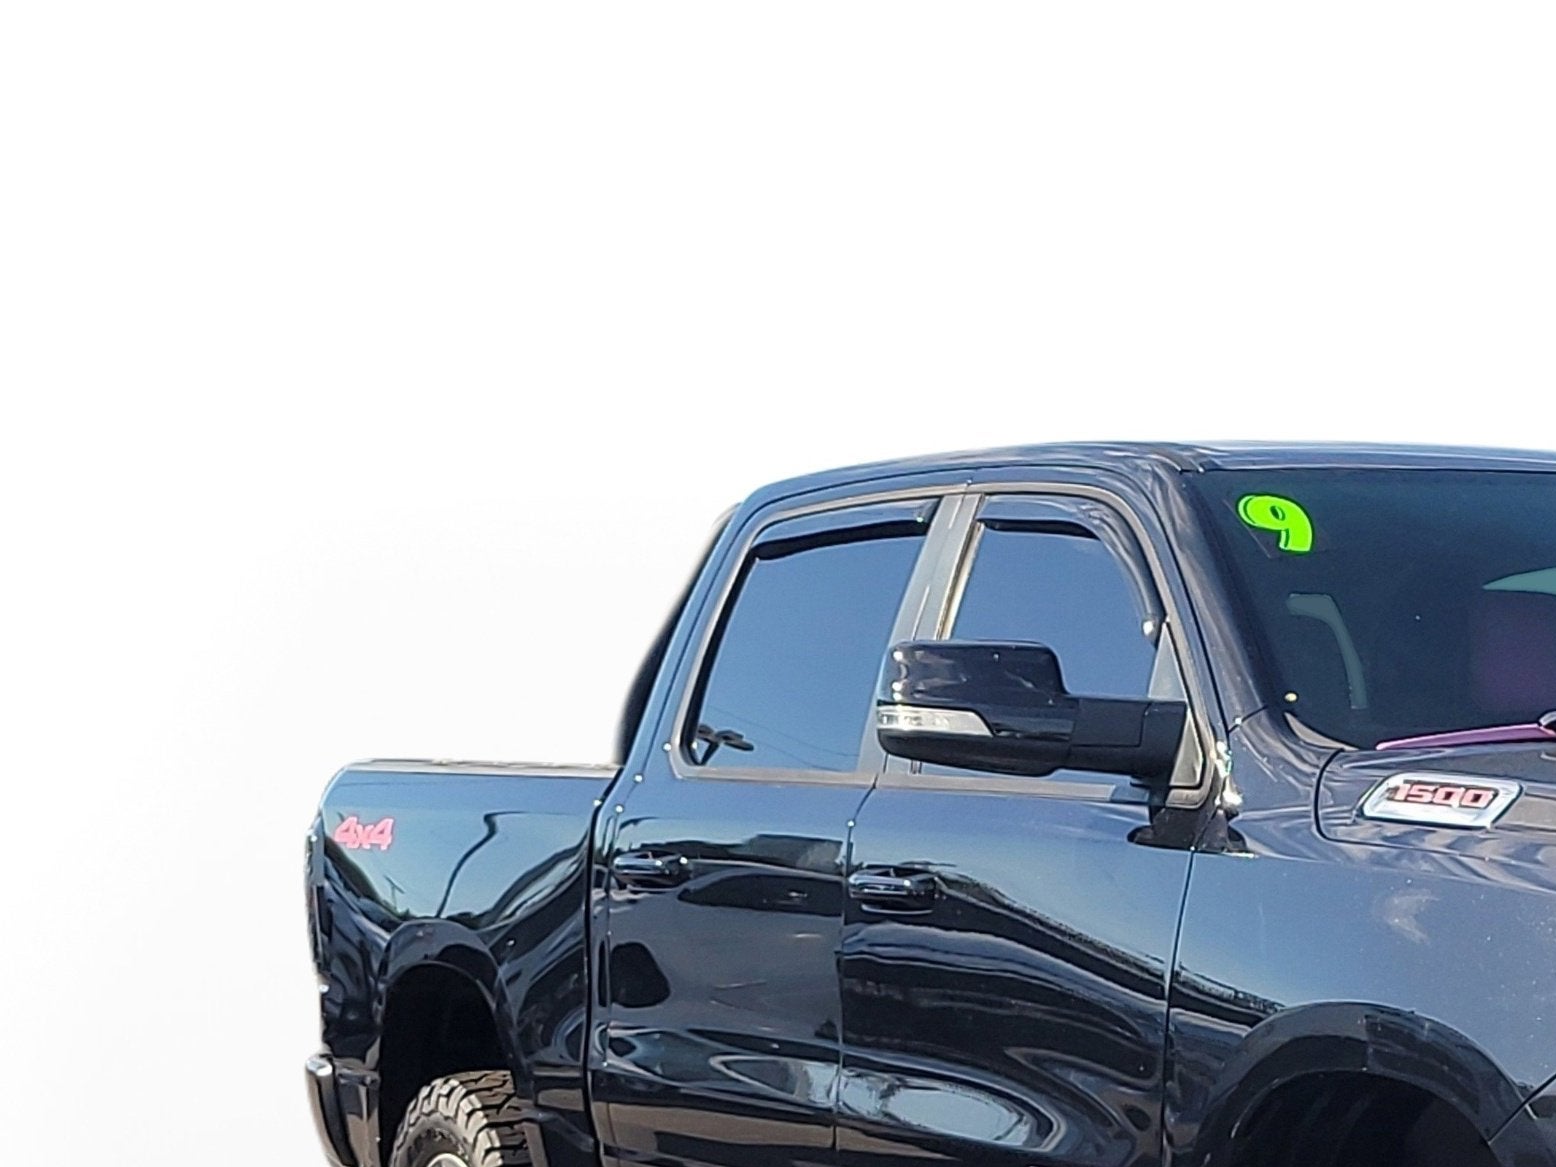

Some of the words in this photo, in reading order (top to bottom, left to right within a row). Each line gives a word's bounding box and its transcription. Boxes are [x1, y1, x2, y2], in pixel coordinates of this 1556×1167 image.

[1237, 493, 1314, 555] 9
[1388, 781, 1498, 809] 1500
[334, 815, 395, 850] 4x4
